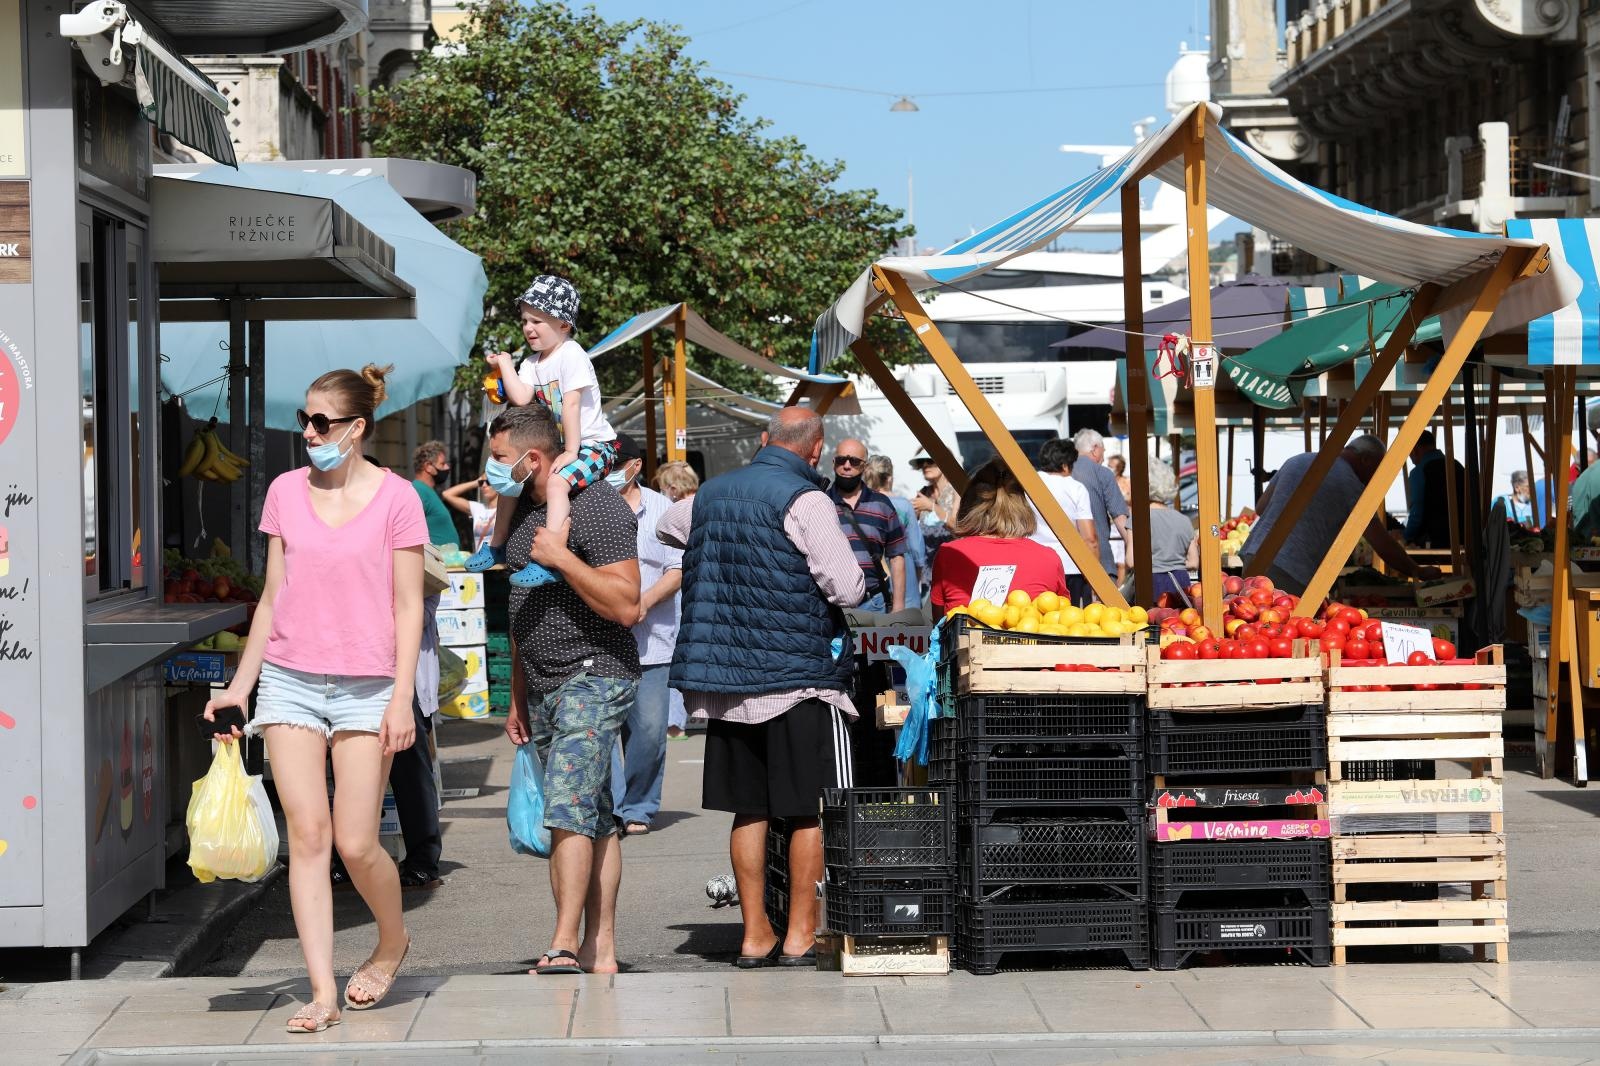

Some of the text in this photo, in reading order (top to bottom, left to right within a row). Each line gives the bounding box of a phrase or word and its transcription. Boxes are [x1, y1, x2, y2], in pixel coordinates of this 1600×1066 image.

[229, 213, 295, 227] RIJEČKE
[229, 228, 295, 241] TRŽNICE
[9, 343, 33, 390] MAJSTORA
[861, 632, 931, 654] Natu
[1221, 789, 1260, 805] frisesa
